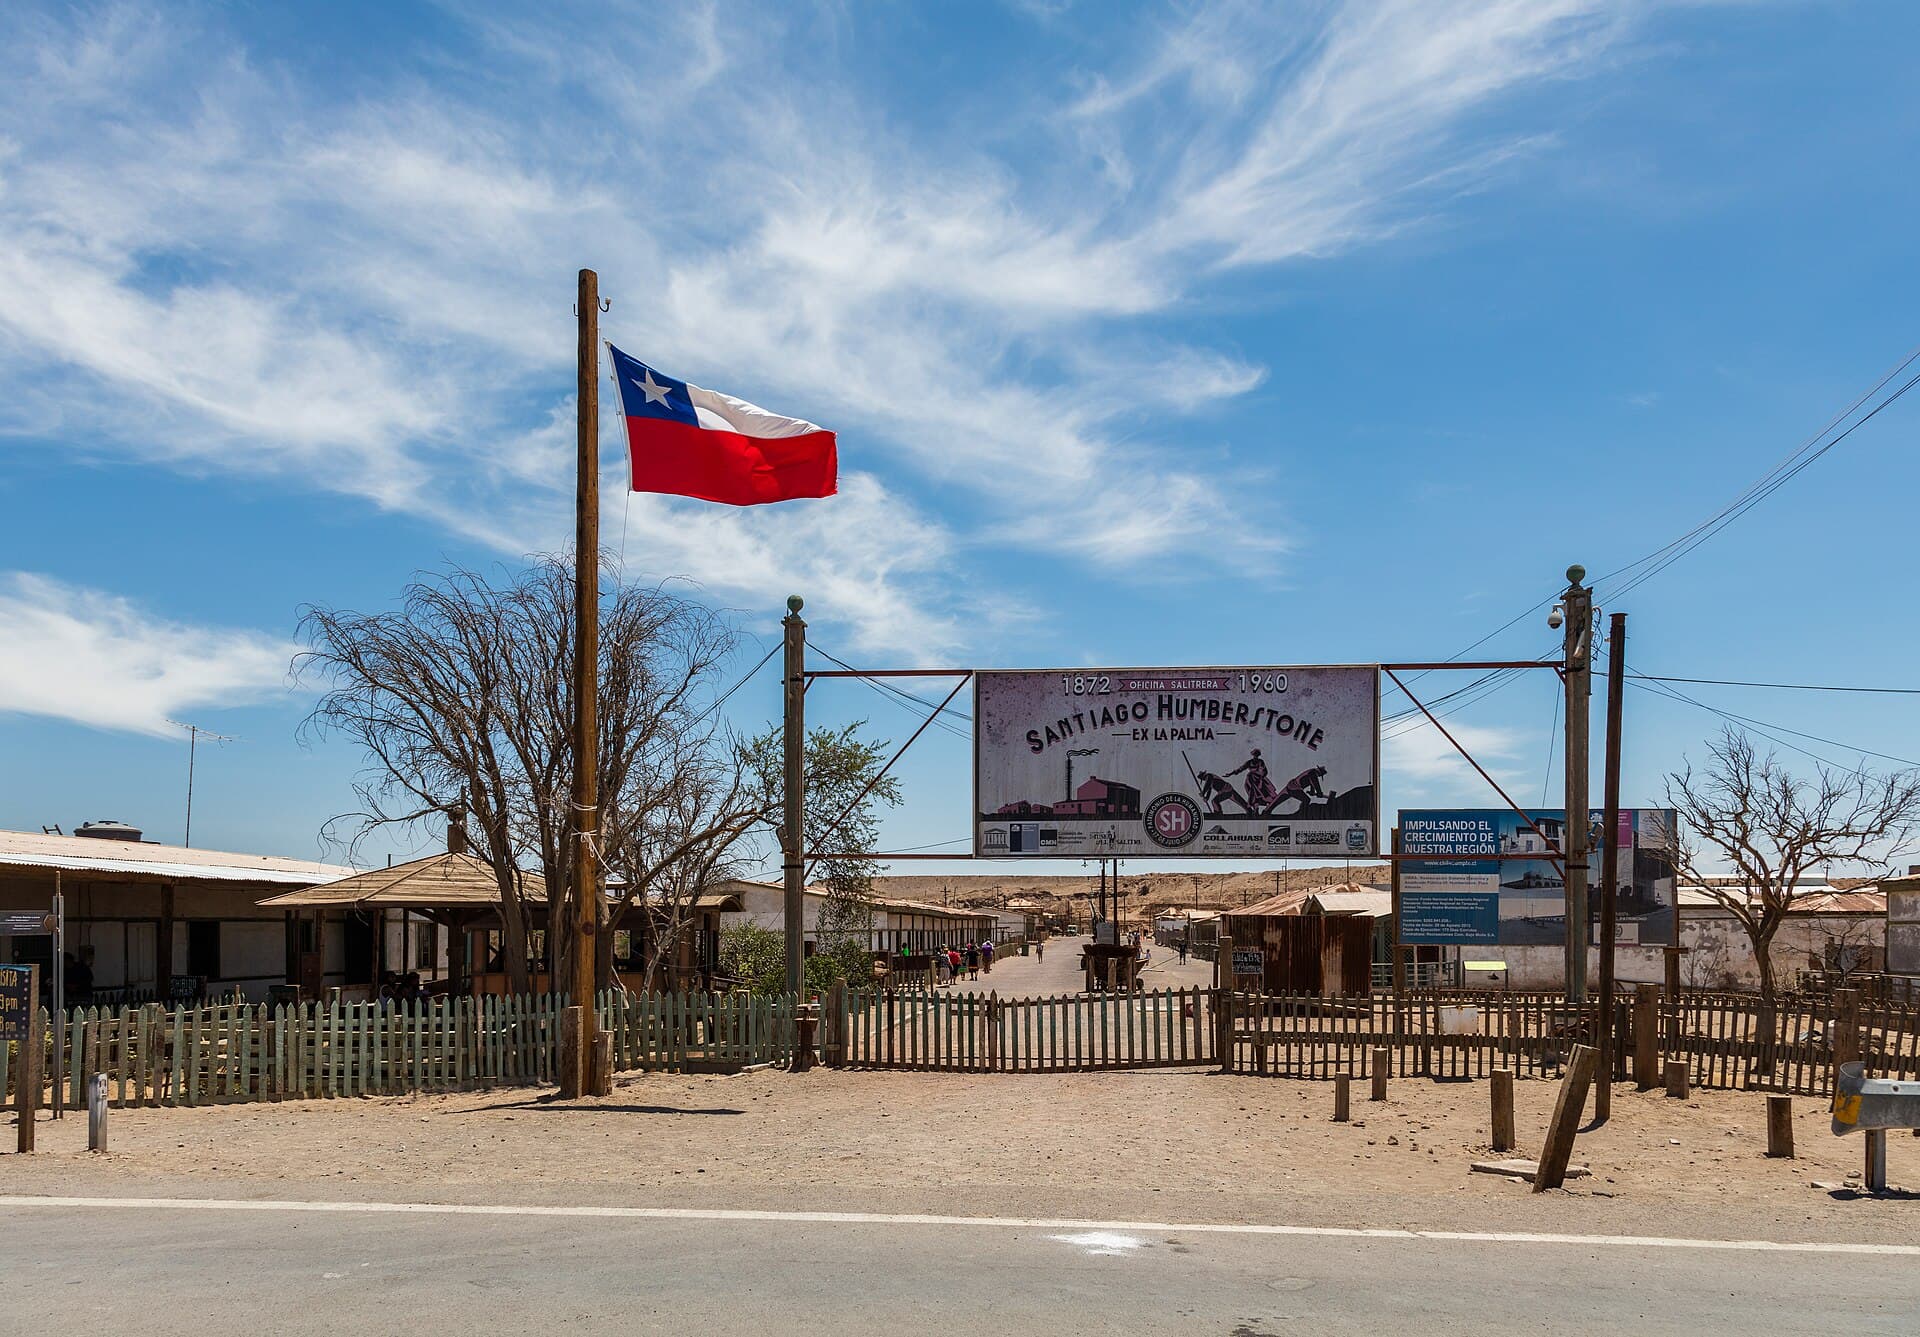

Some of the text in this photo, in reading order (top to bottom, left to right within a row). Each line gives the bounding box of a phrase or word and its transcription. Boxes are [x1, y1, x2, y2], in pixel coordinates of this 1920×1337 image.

[1062, 677, 1110, 696] 1872
[1129, 680, 1218, 689] OFICINA SALITRERA
[1239, 674, 1288, 693] 1960
[1026, 694, 1324, 754] SANTIAGO HUMBERSTONE
[1132, 728, 1214, 741] EX LA PALMA
[1160, 810, 1186, 832] SH
[1405, 820, 1491, 831] IMPULSANDO EL
[1269, 836, 1290, 845] SQM
[1405, 832, 1494, 842] CRECIMIENTO DE
[1405, 842, 1496, 854] NUESTRA REGIÓN
